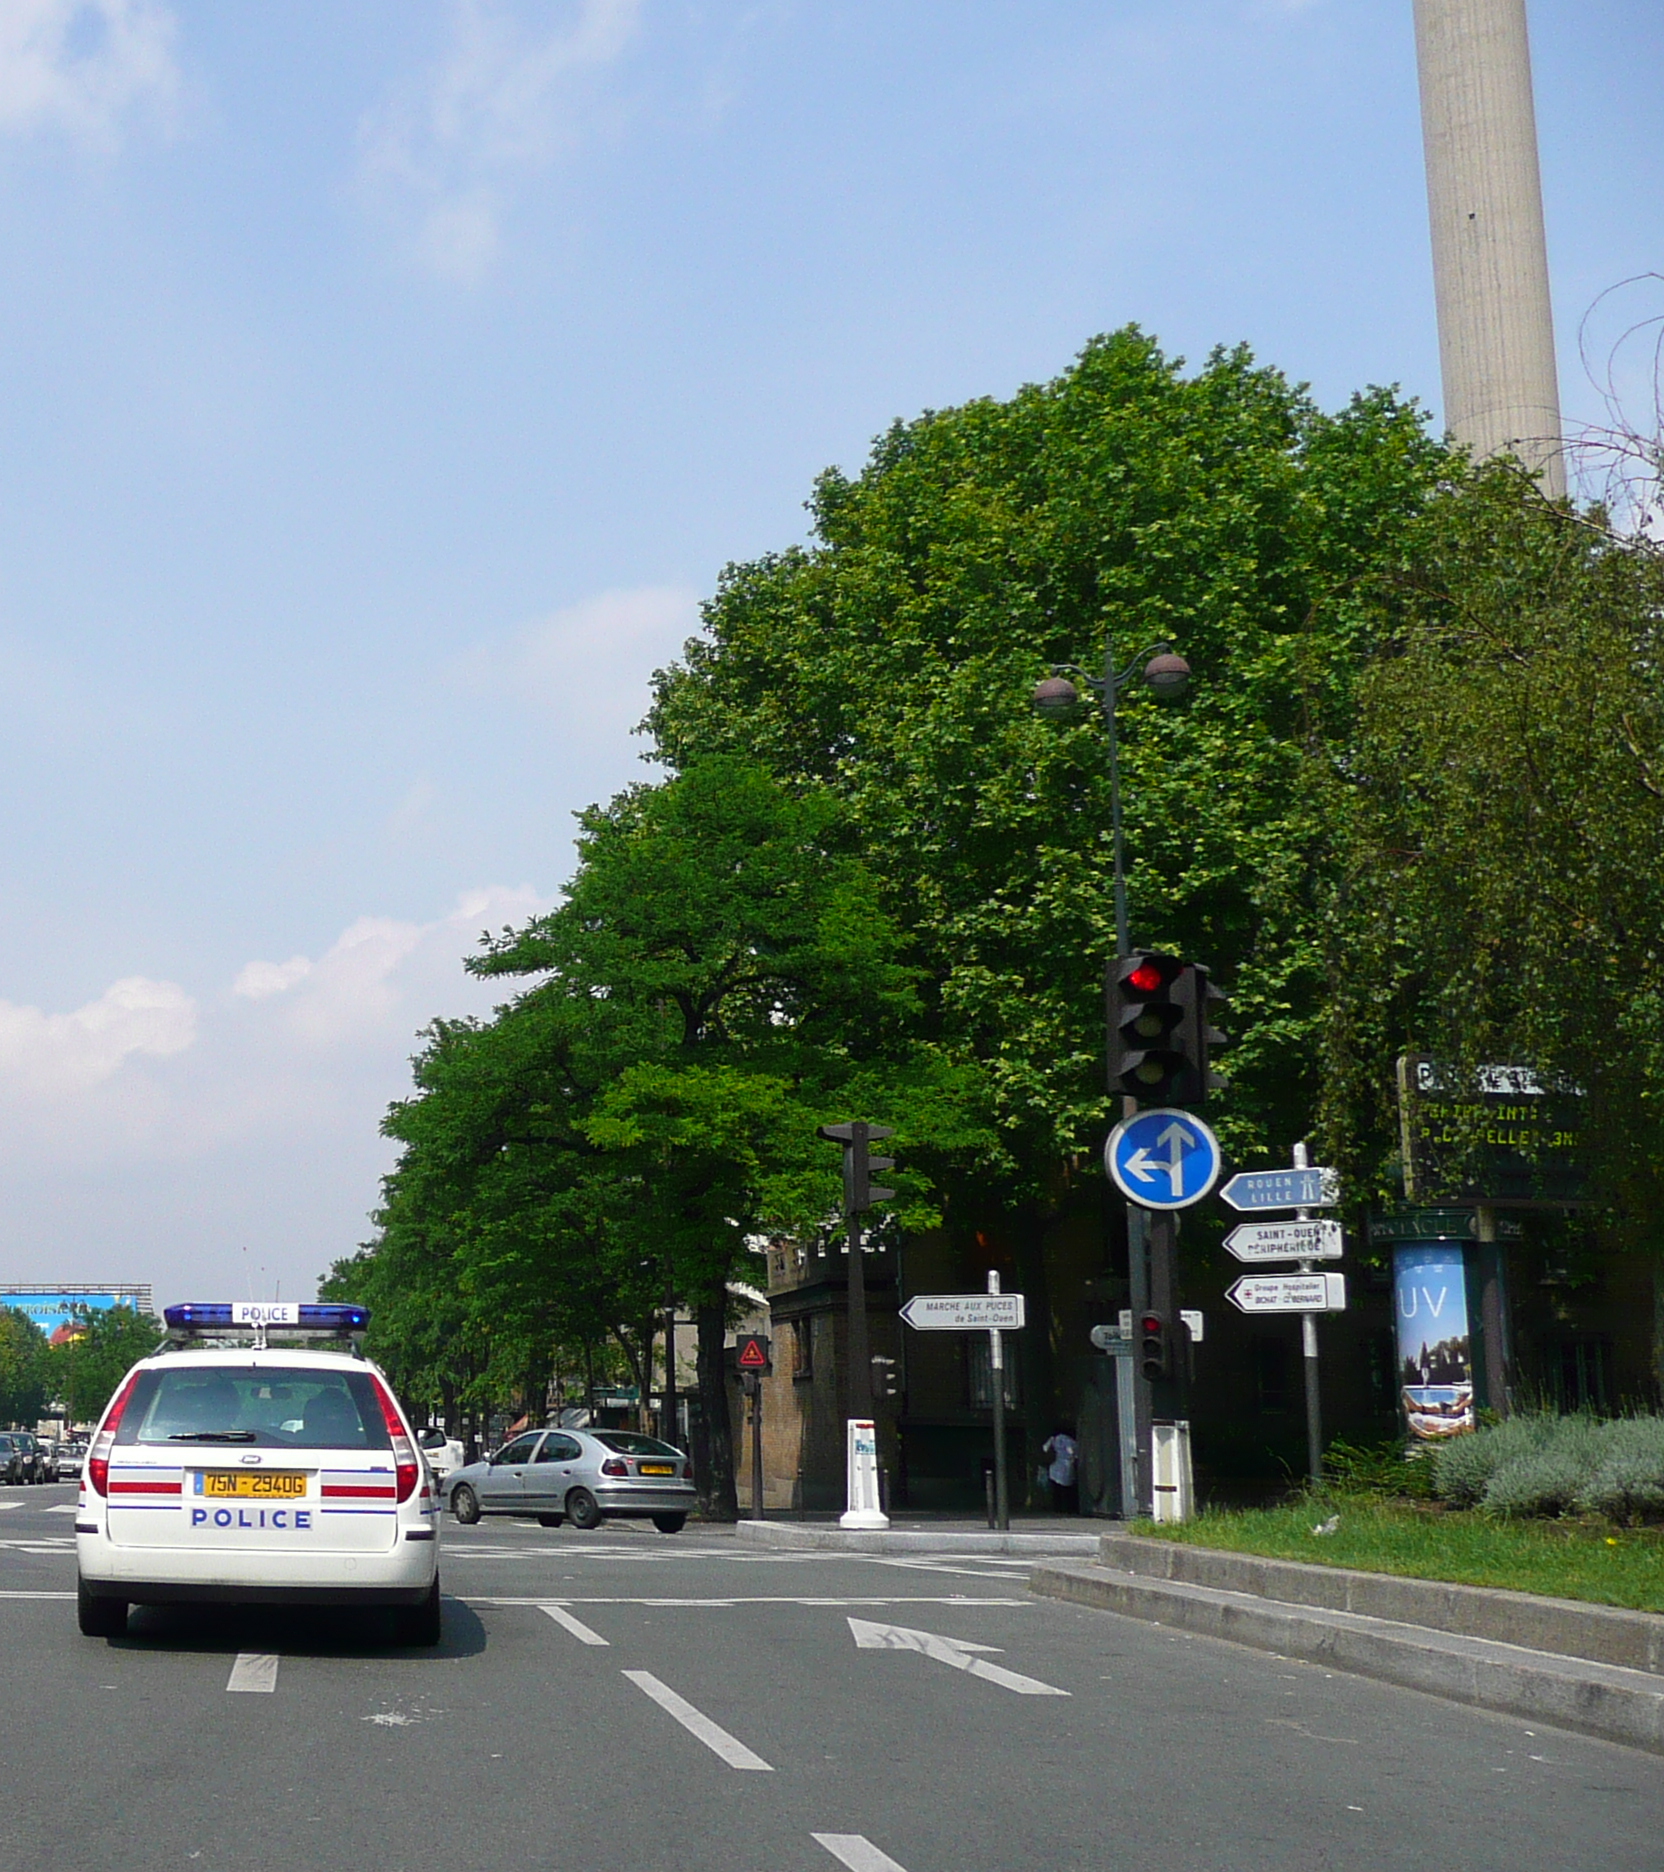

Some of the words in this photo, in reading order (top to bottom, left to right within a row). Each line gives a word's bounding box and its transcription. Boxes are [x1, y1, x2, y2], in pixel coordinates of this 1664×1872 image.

[1247, 1176, 1293, 1190] ROUEN
[1251, 1190, 1293, 1203] LILLE
[925, 1302, 960, 1312] MARCHE
[964, 1302, 982, 1310] AUX
[986, 1301, 1013, 1310] PUCES
[1400, 1286, 1447, 1318] UV
[241, 1306, 289, 1321] POLICE
[954, 1314, 964, 1323] de
[207, 1474, 237, 1492] 75N
[252, 1475, 303, 1493] 2940G
[192, 1508, 311, 1527] POLICE
